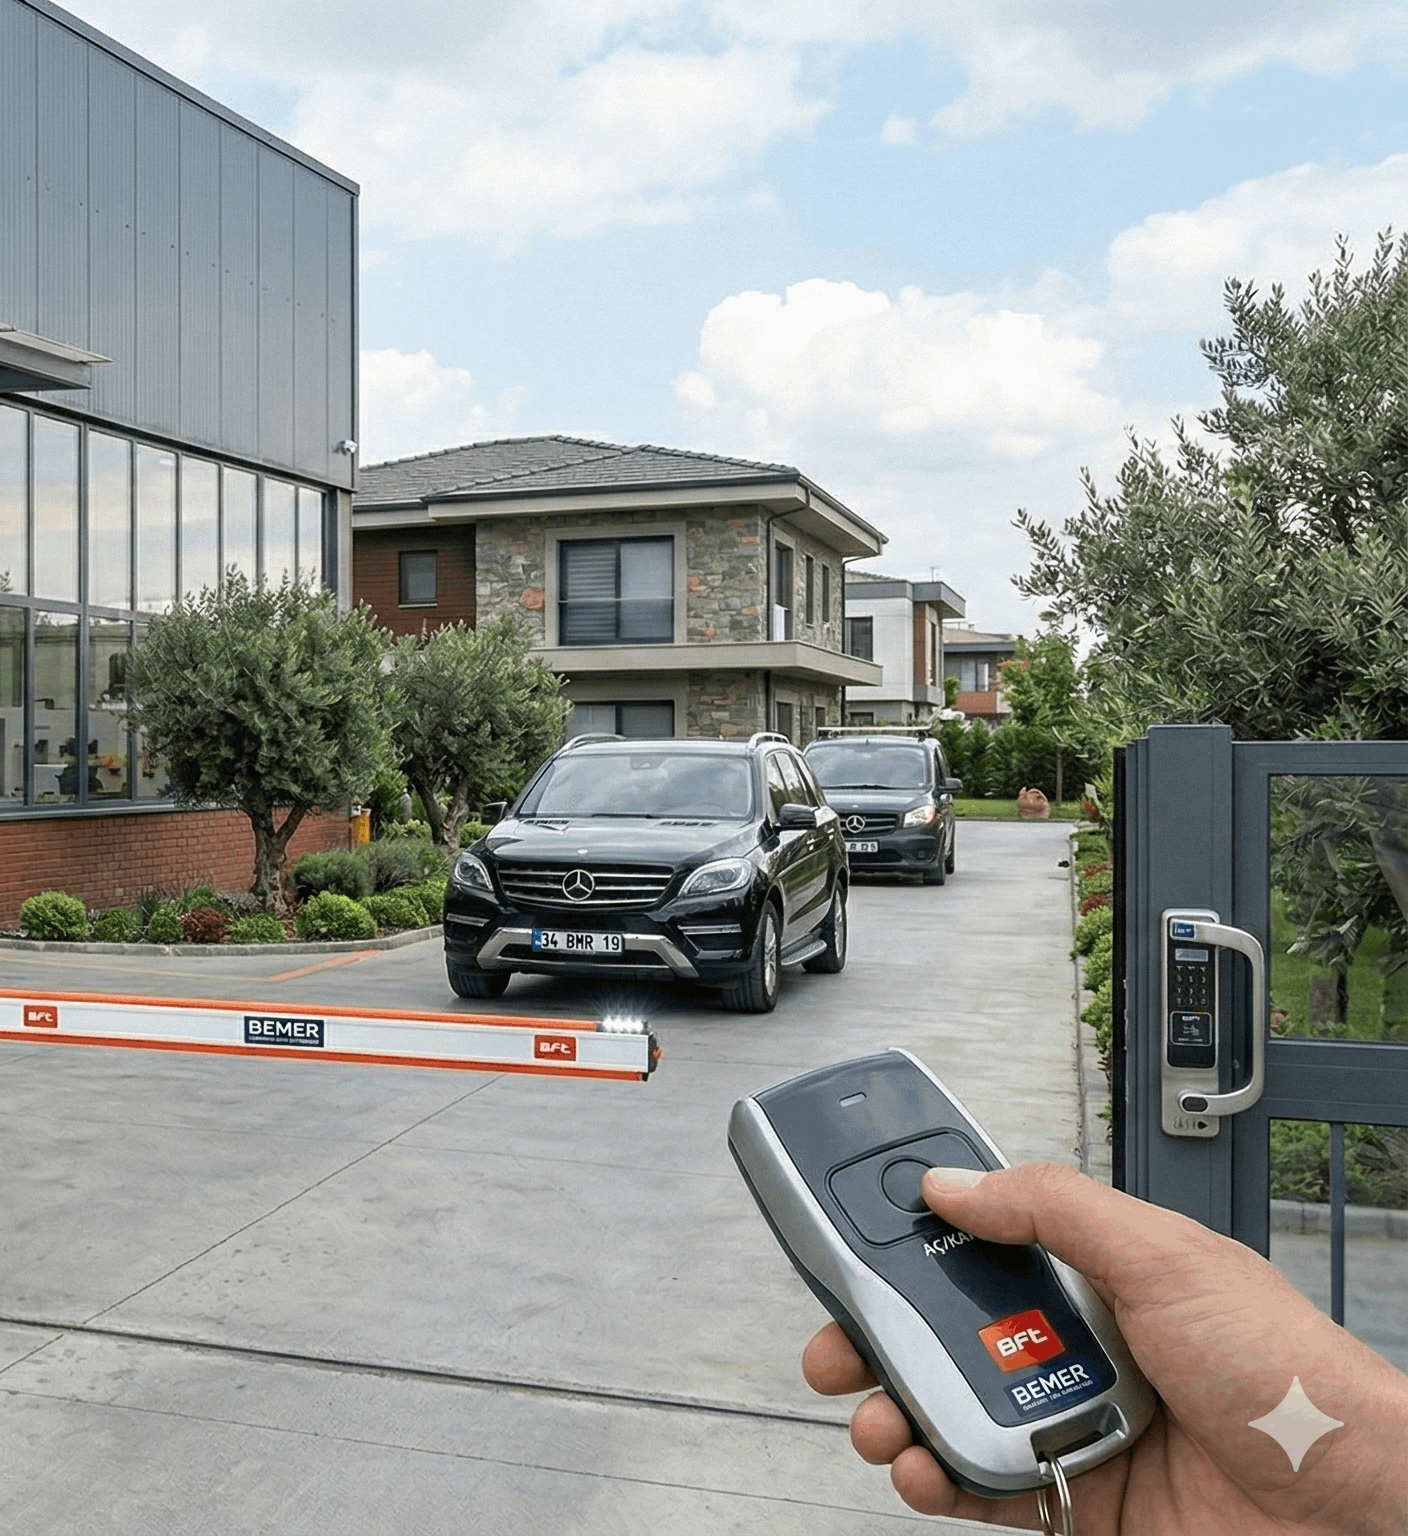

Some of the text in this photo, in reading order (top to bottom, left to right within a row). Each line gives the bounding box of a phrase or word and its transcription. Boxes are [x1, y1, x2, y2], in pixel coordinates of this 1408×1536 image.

[541, 932, 559, 949] 34
[566, 933, 594, 951] BMR
[603, 935, 620, 951] 19
[248, 1020, 320, 1038] BEMER
[1011, 1363, 1090, 1405] BEMER
